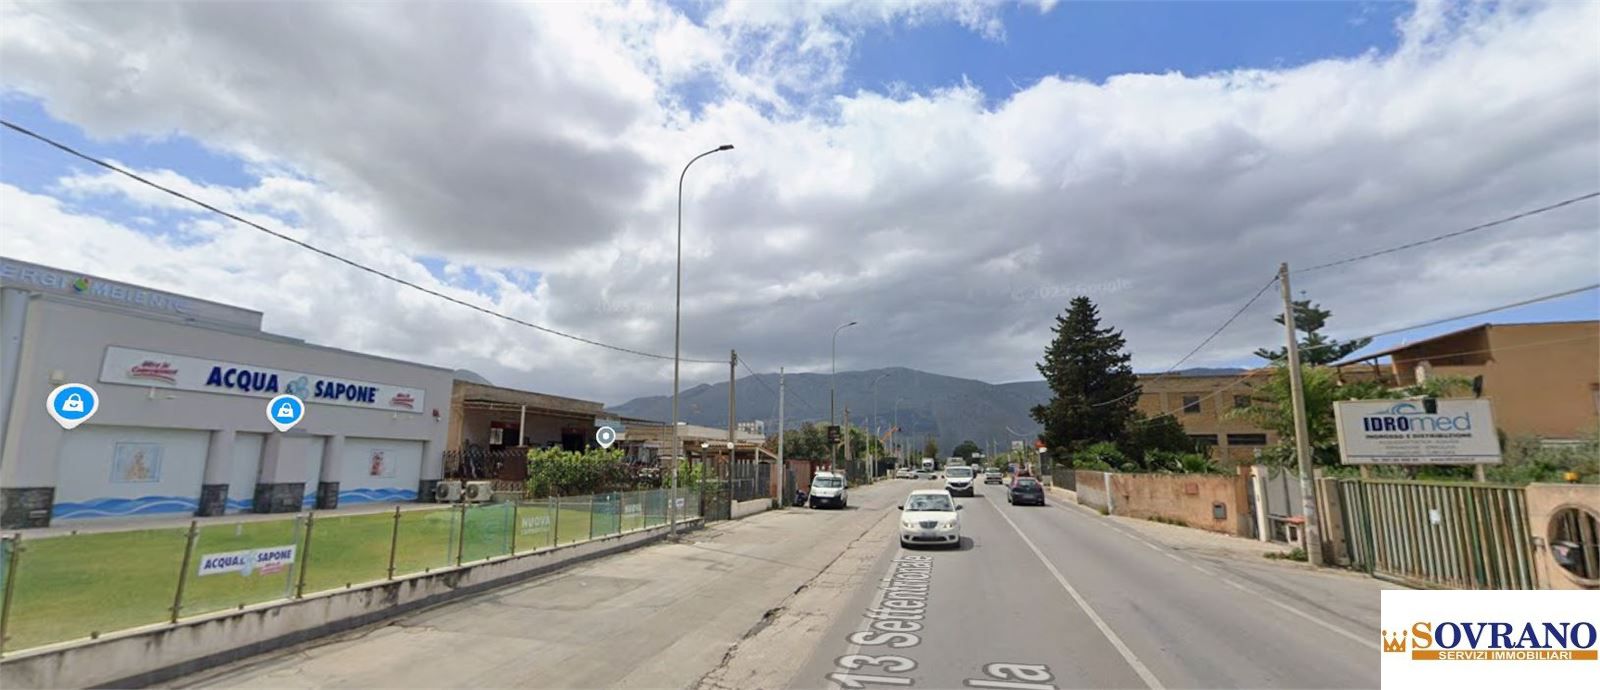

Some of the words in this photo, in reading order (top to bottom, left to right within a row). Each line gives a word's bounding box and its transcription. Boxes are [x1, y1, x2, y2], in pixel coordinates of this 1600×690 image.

[205, 366, 278, 393] ACQUA
[313, 380, 376, 404] SAPONE
[1364, 411, 1471, 432] IDROmed
[204, 556, 238, 570] ACQUA
[257, 550, 292, 563] SAPONE
